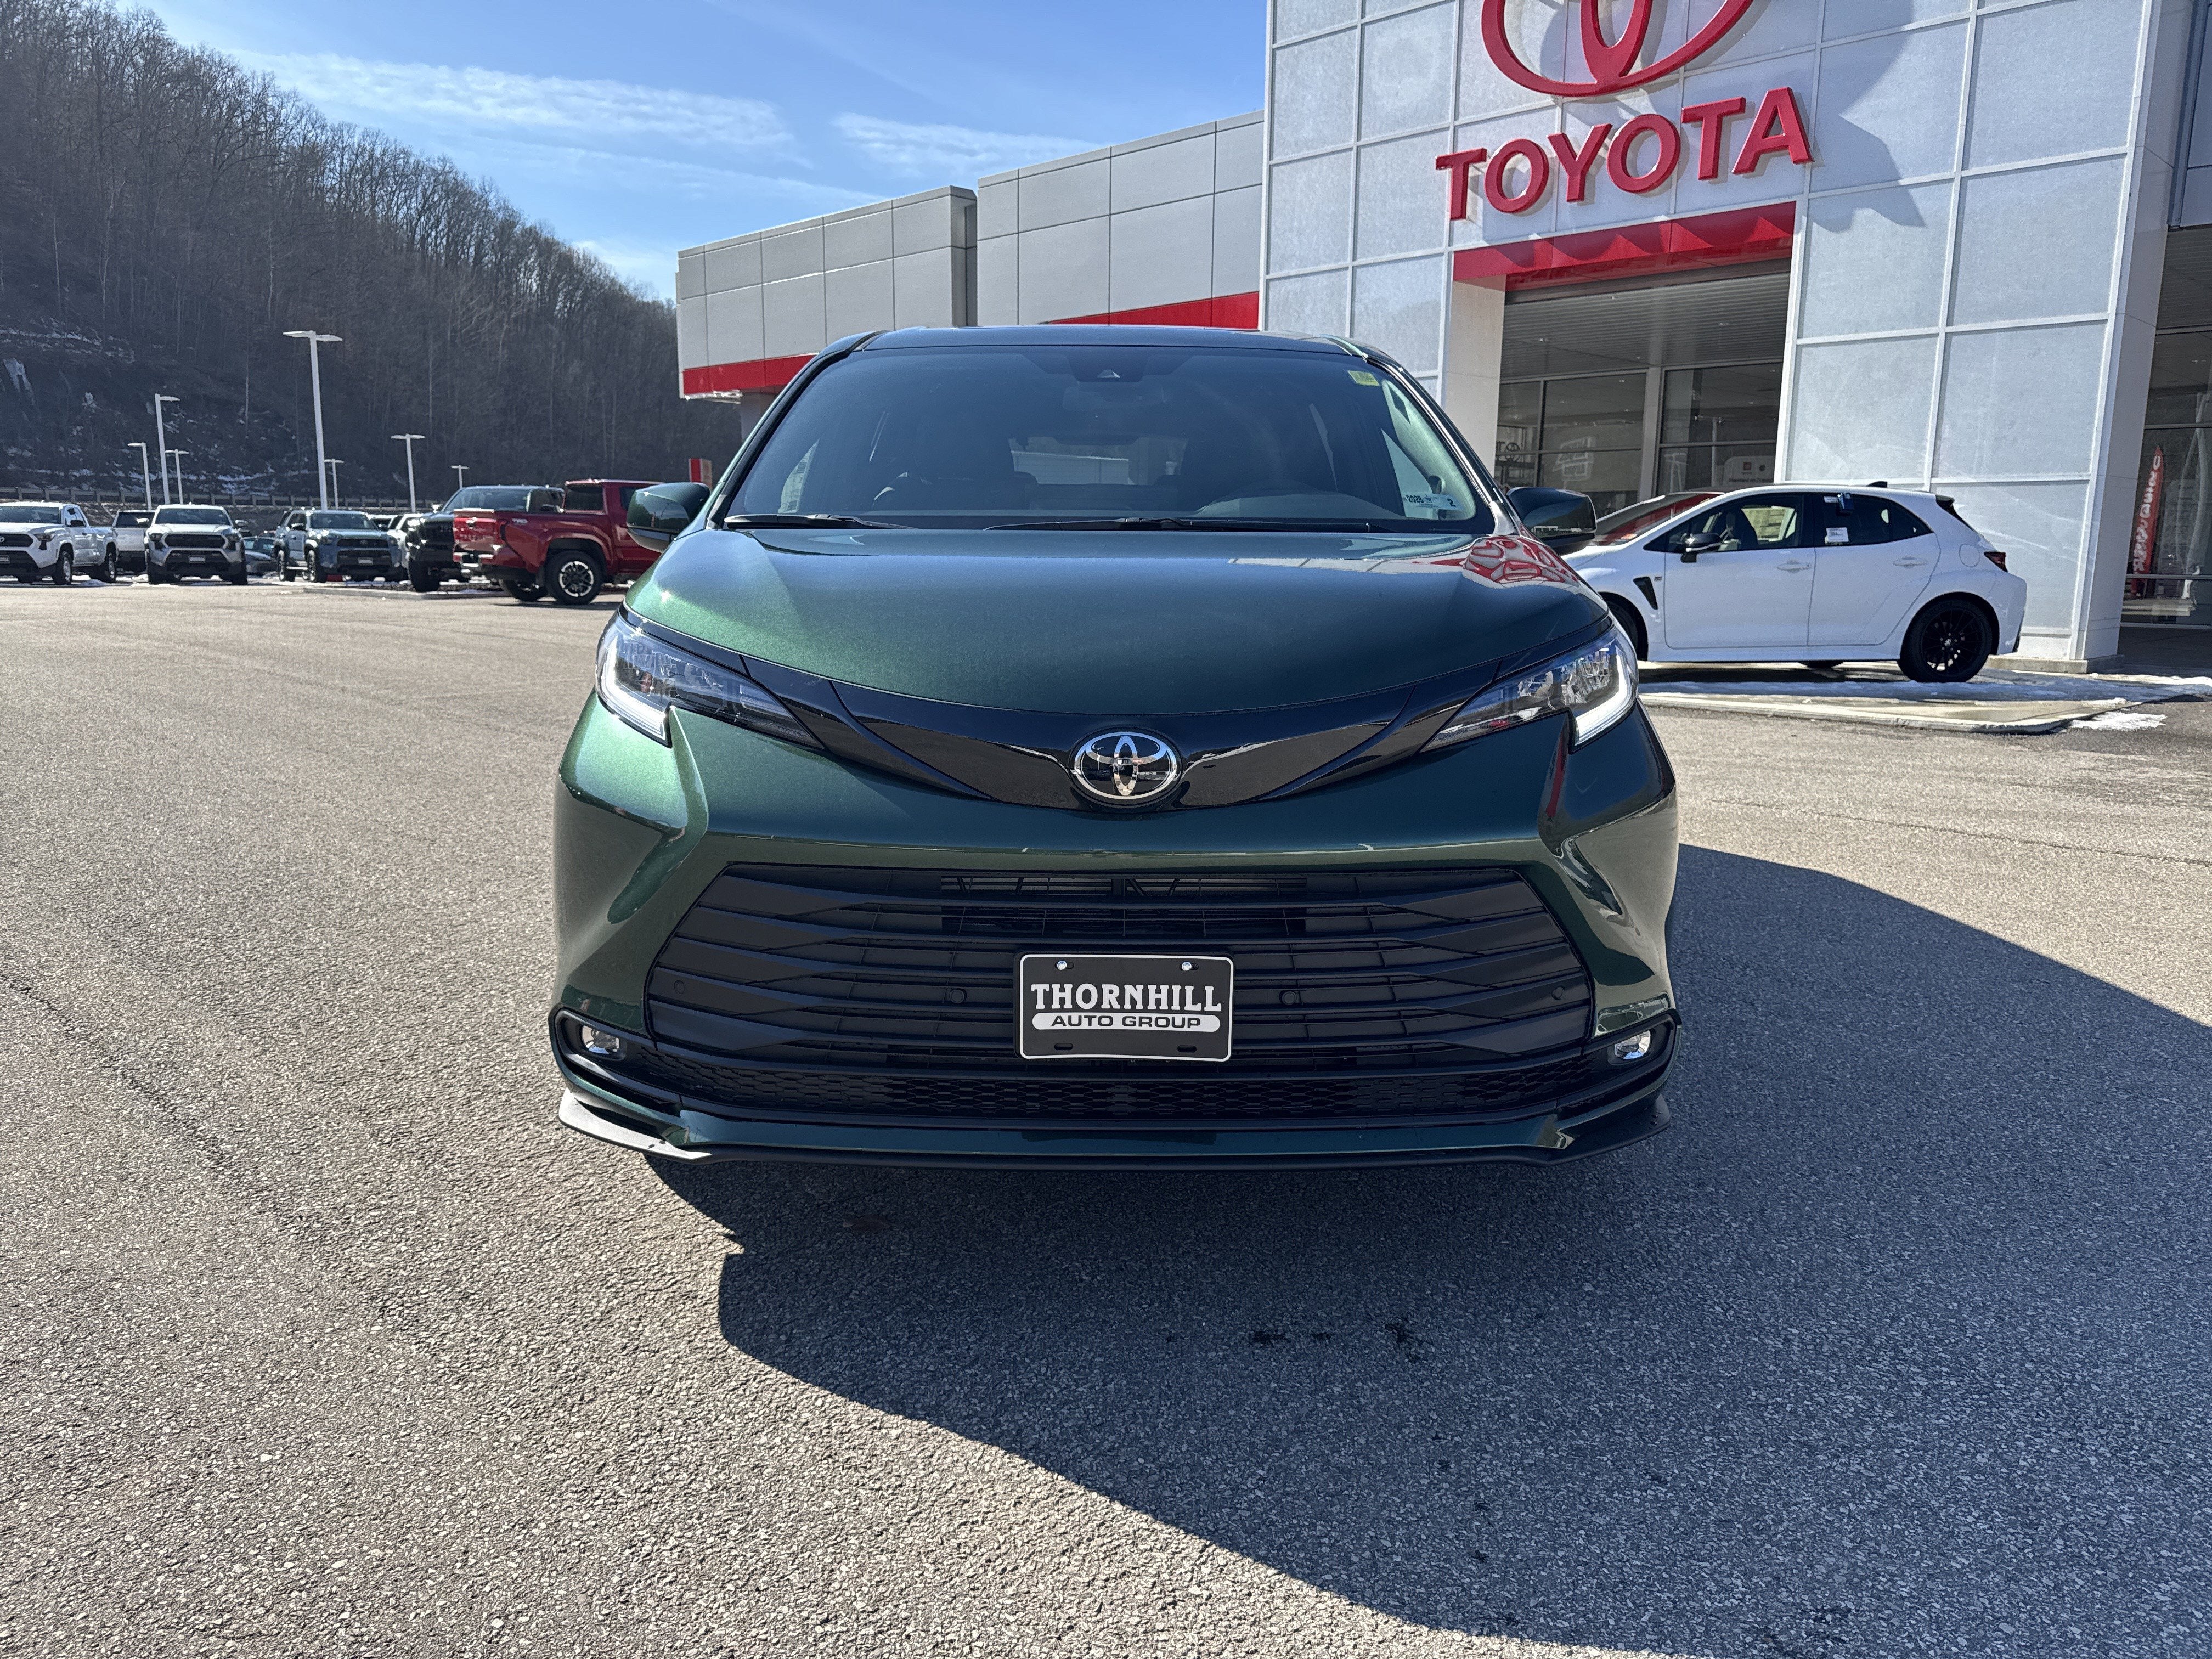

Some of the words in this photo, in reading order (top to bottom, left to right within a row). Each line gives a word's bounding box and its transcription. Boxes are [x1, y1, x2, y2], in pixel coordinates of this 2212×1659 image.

[1436, 87, 1813, 221] TOYOTA
[1031, 983, 1222, 1012] THORNHILL
[1051, 1015, 1114, 1027] AUTO
[1122, 1015, 1201, 1029] GROUP
